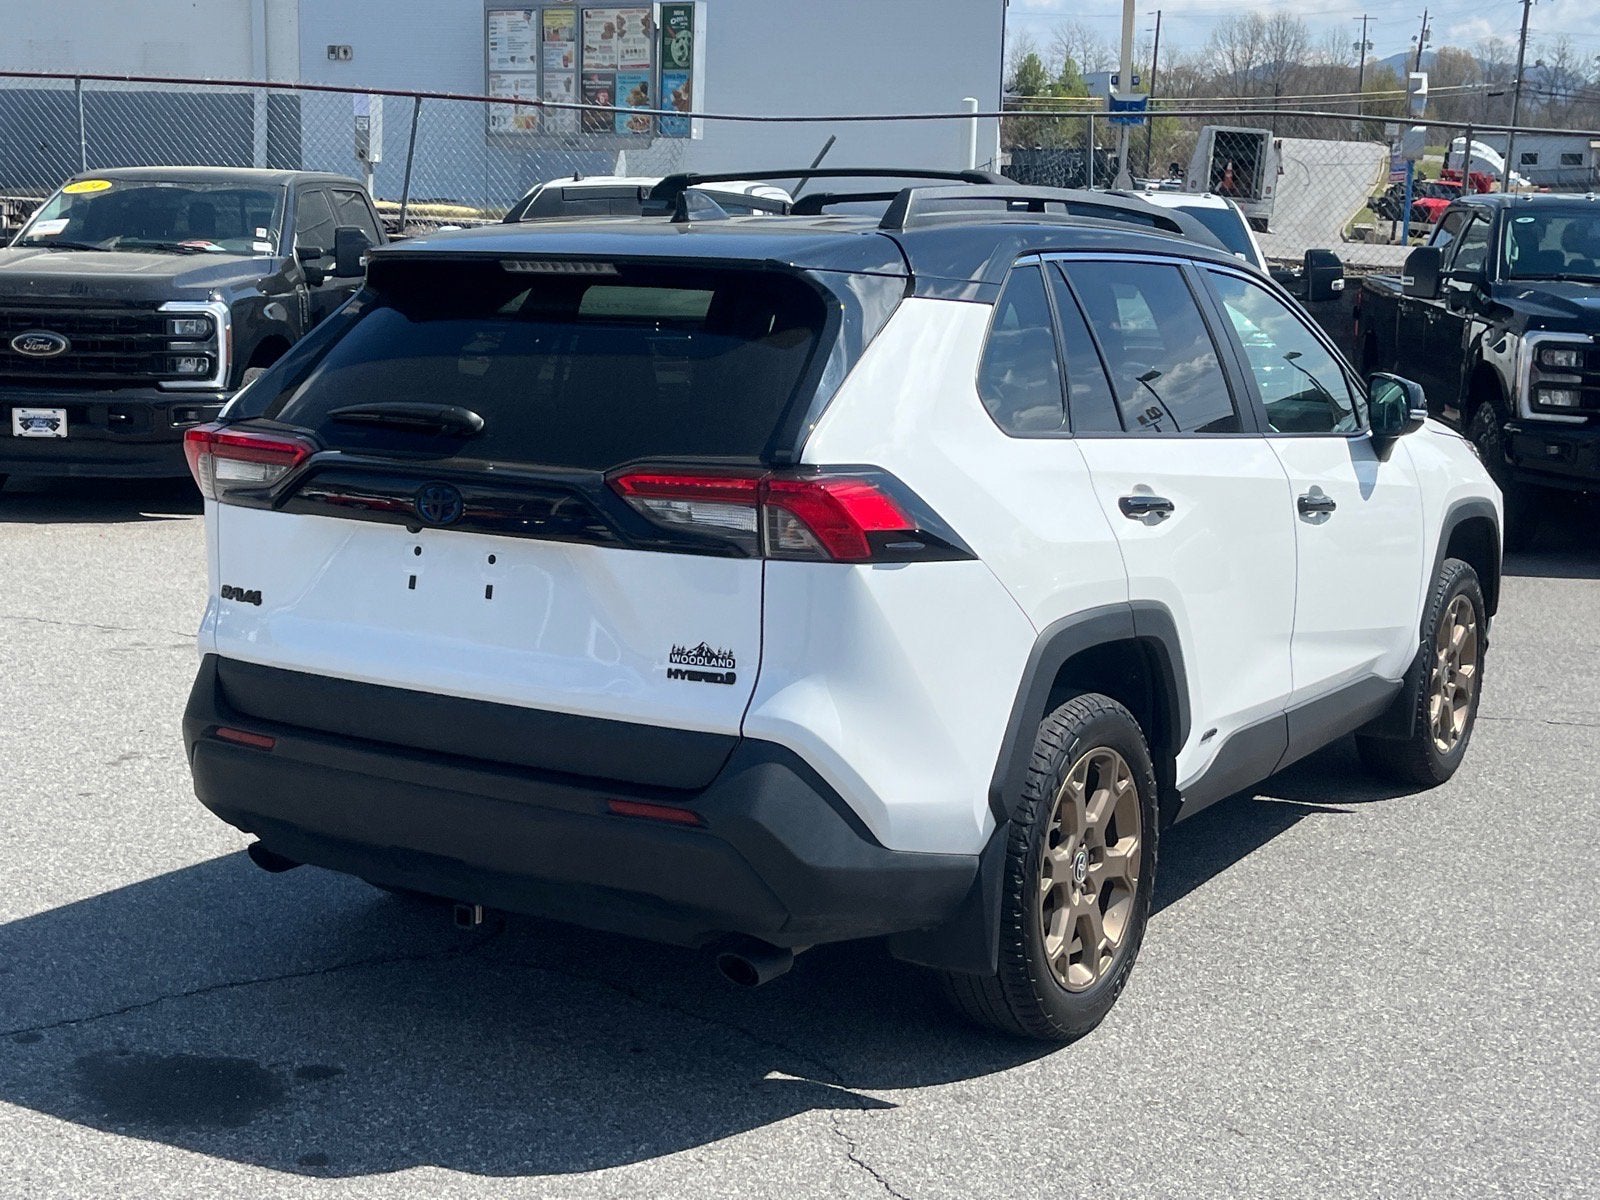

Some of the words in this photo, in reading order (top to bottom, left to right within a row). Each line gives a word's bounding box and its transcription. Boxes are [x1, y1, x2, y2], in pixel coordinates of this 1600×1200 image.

[23, 337, 52, 351] Ford
[221, 584, 262, 606] RAV4
[671, 653, 734, 668] WOODLAND
